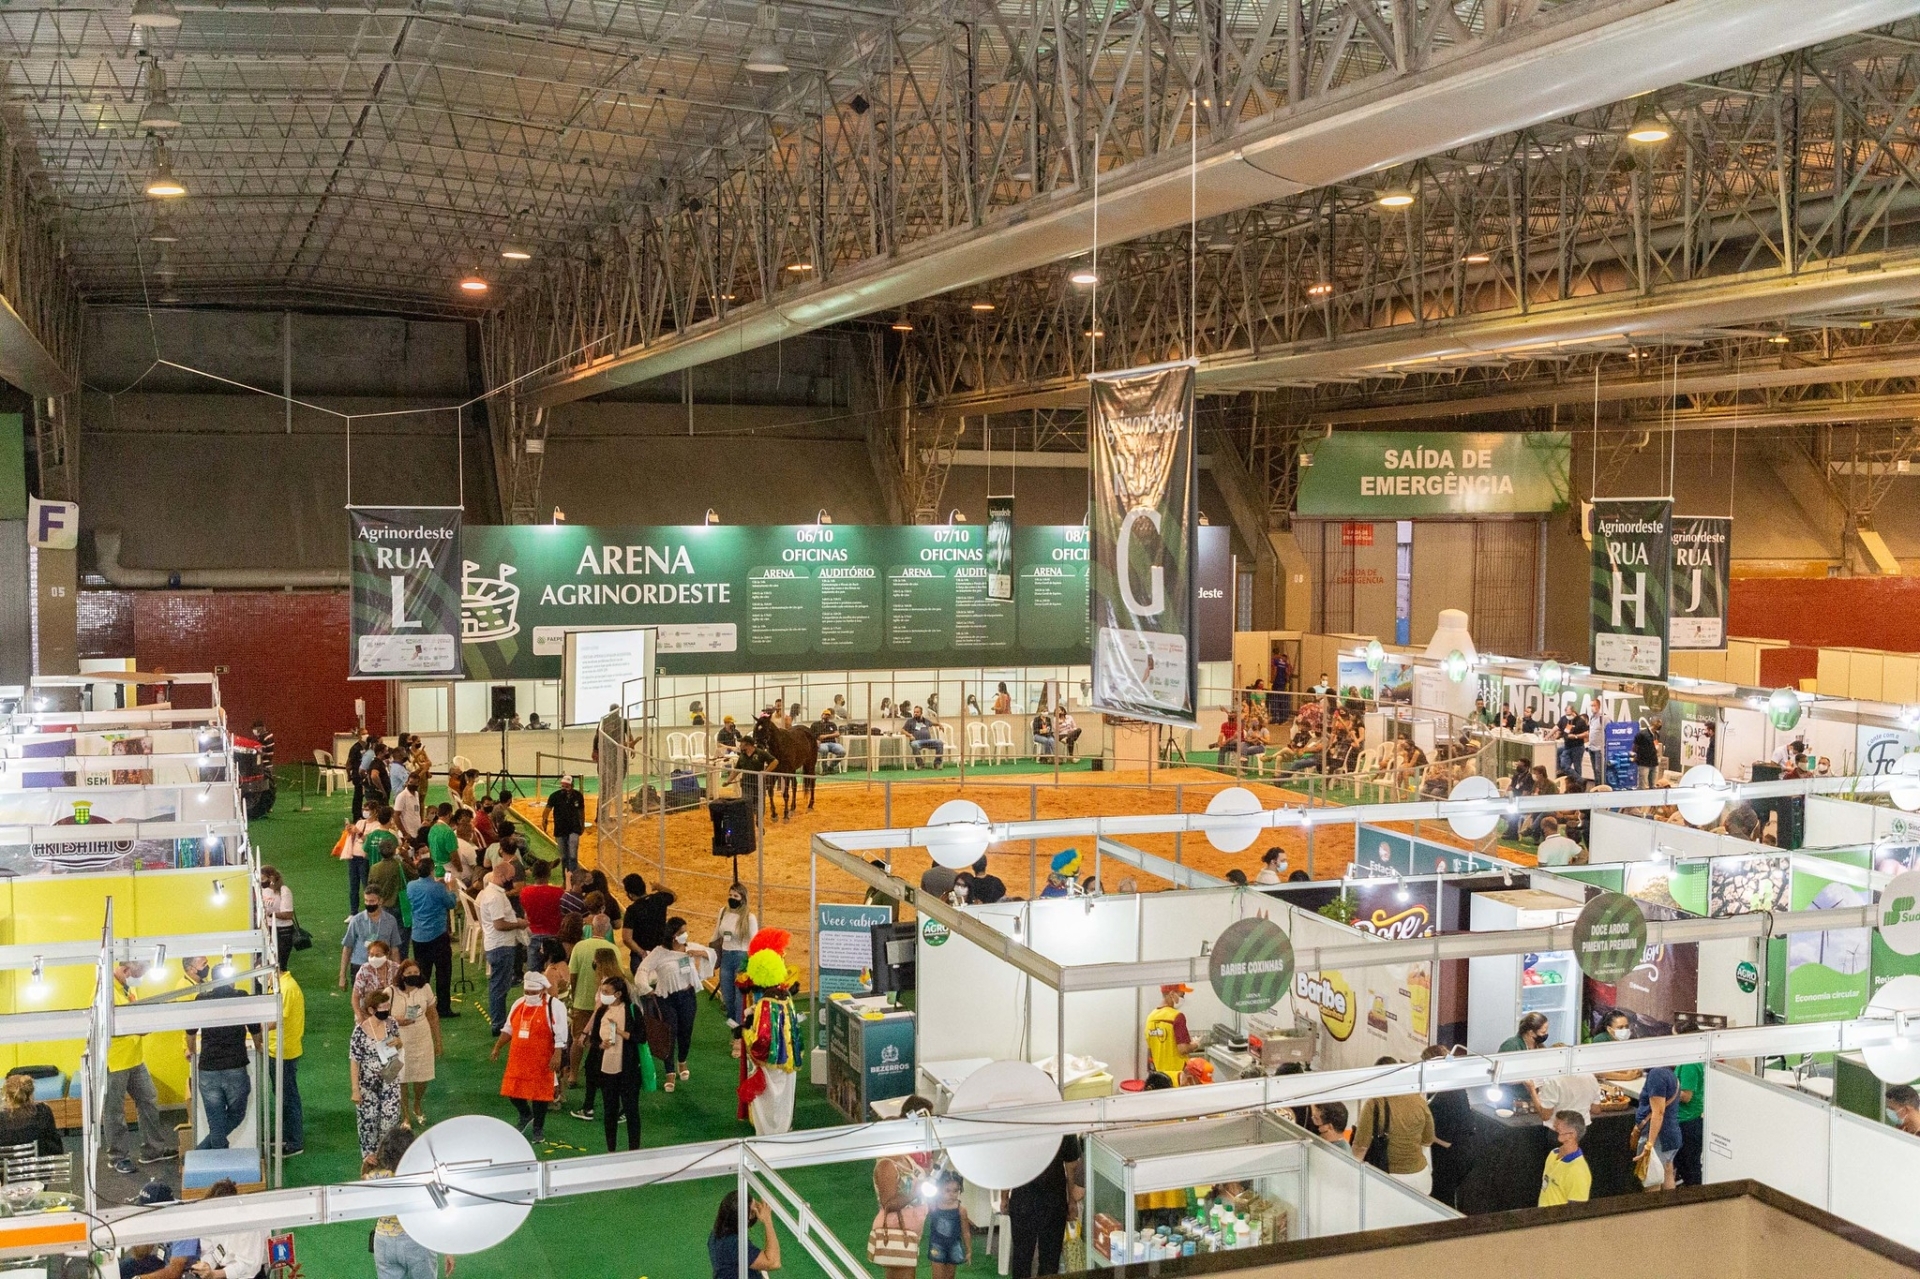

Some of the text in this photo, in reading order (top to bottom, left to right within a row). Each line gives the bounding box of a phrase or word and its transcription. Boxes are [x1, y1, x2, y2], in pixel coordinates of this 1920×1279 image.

[1384, 445, 1492, 469] SAÍDA DE
[1360, 472, 1514, 496] EMERGÊNCIA
[38, 505, 66, 543] F
[1598, 518, 1664, 537] Agrinordeste
[358, 525, 454, 543] Agrinordeste
[796, 529, 834, 544] 06/10
[933, 529, 970, 543] 07/10
[1671, 531, 1726, 545] grinordeste
[377, 547, 435, 569] RUA
[576, 545, 696, 575] ARENA
[782, 548, 848, 563] OFICINAS
[920, 548, 983, 562] OFICINAS
[1116, 506, 1165, 617] G
[1609, 541, 1649, 566] RUA
[1676, 548, 1712, 566] RUA
[763, 568, 795, 577] ARENA
[819, 565, 875, 577] AUDITÓRIO
[902, 567, 932, 577] ARENA
[1033, 567, 1063, 576] ARENA
[540, 583, 731, 606] AGRINORDESTE
[1685, 569, 1701, 613] J
[391, 575, 422, 628] L
[1611, 572, 1646, 629] H
[821, 910, 847, 926] Você
[1591, 923, 1630, 936] DOCE ARDOR
[1582, 938, 1638, 953] PIMENTA PREMIUM
[1220, 958, 1284, 976] BARIBE COXINHAS
[1296, 971, 1347, 1015] Baribe
[1795, 989, 1860, 1003] Economia circular
[870, 1063, 910, 1073] BEZERROS
